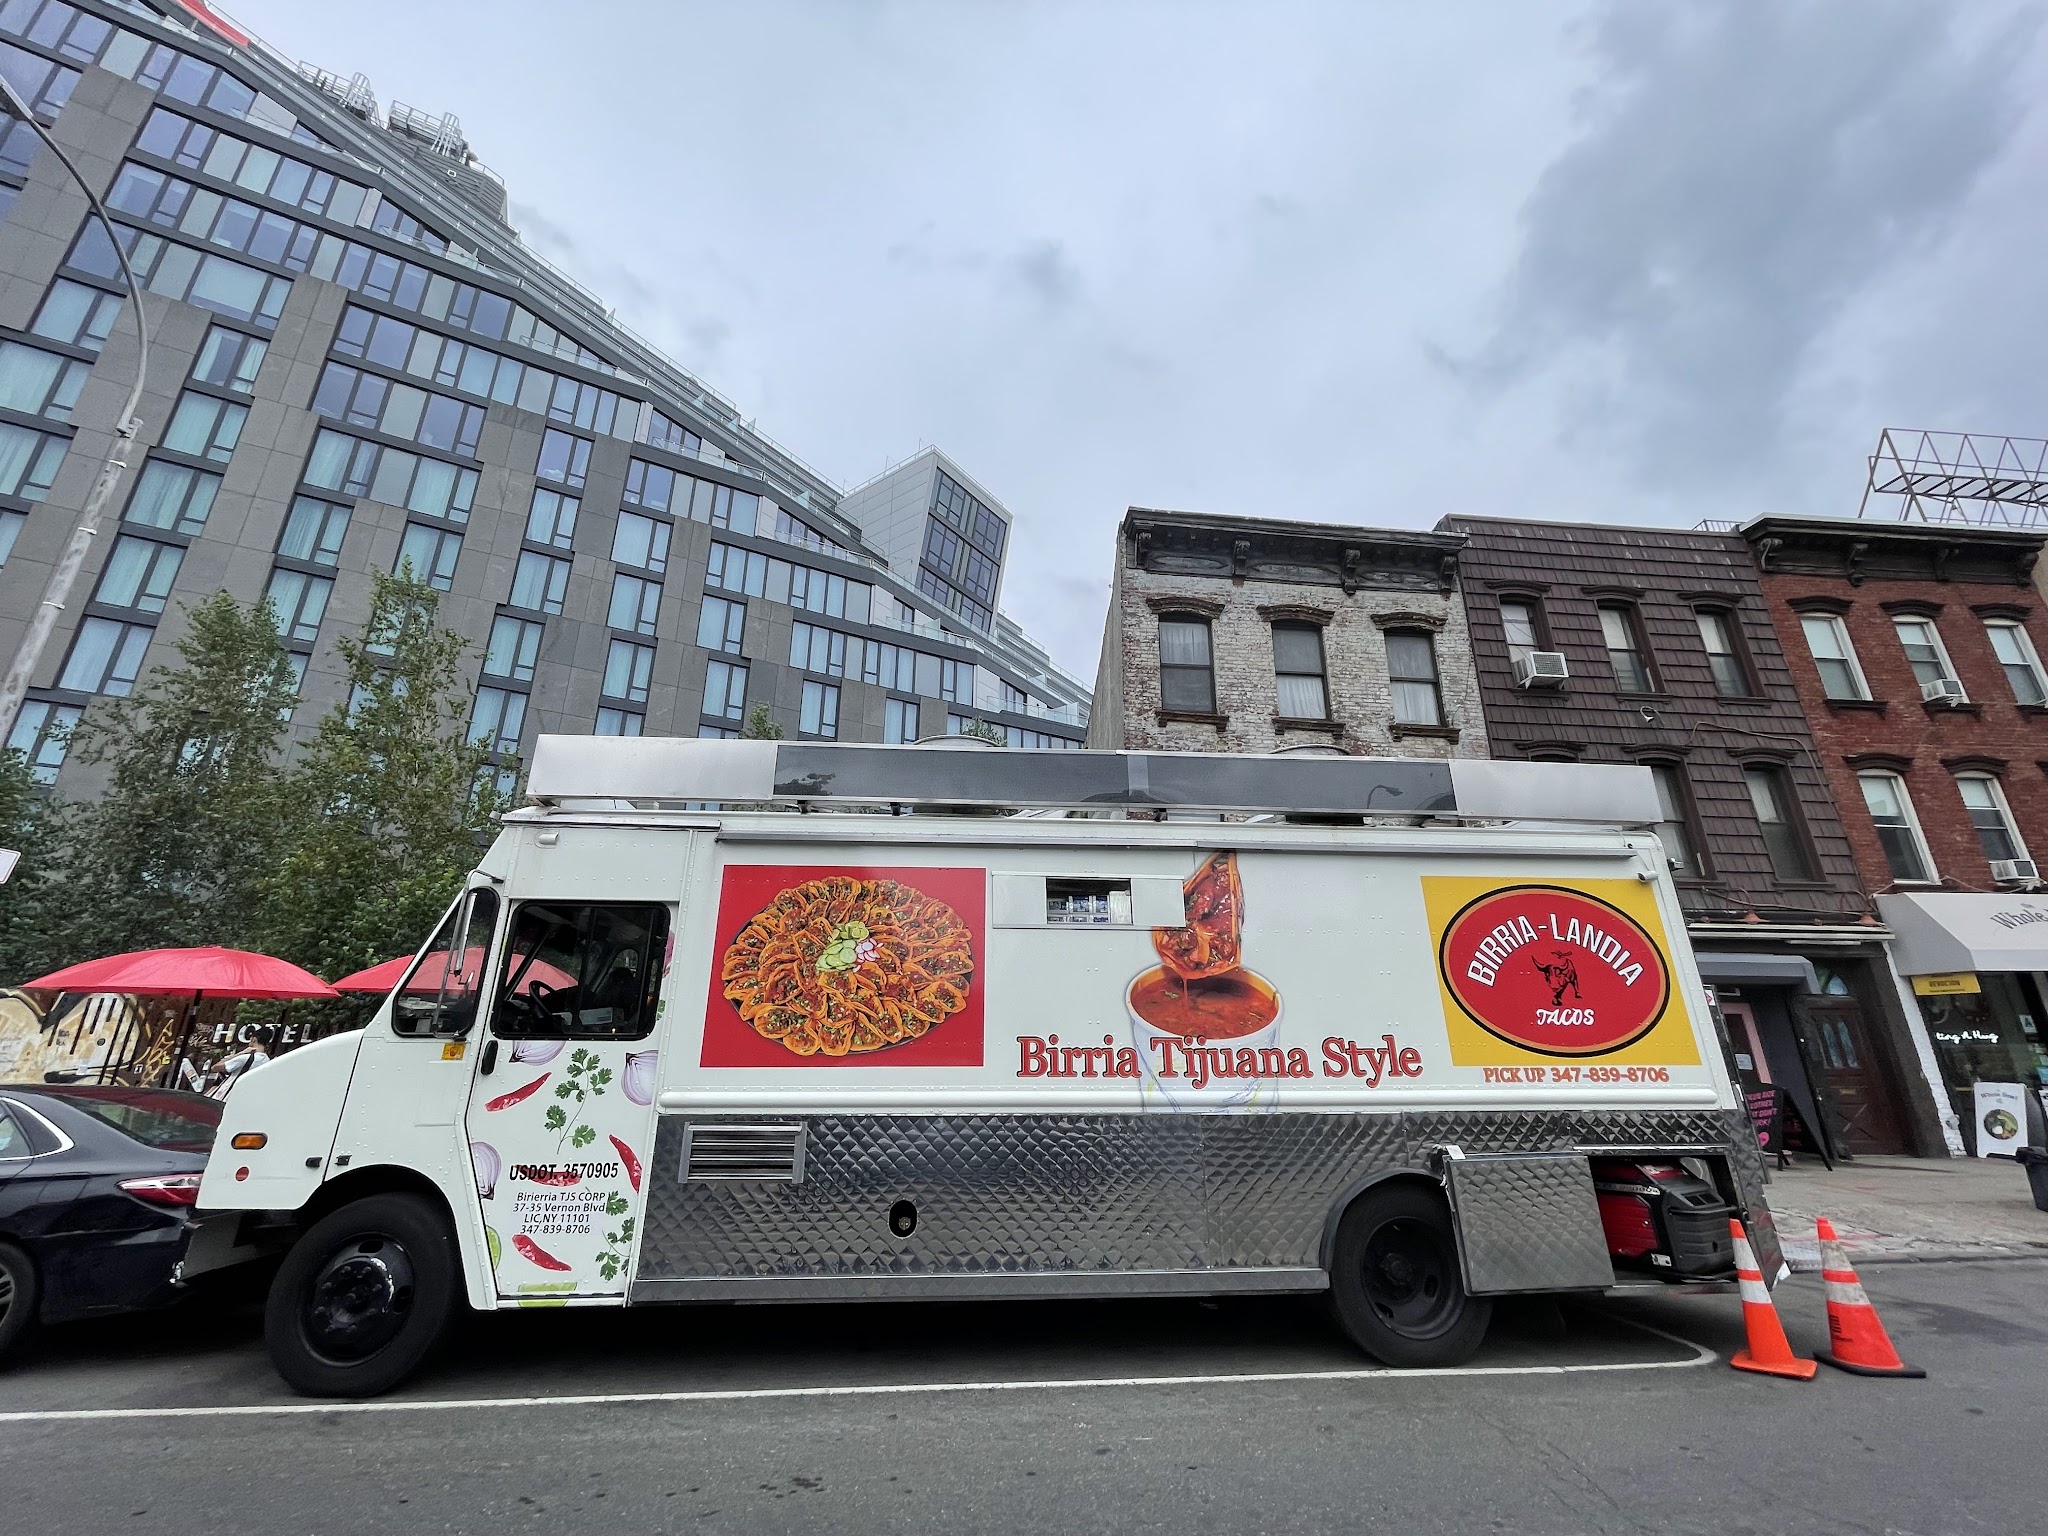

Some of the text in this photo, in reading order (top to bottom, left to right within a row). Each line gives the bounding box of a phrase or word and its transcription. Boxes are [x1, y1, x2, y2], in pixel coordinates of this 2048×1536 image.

[1990, 909, 2048, 929] Whole
[1536, 1008, 1595, 1026] TACOS
[1016, 1034, 1424, 1090] Birria Tijuana Style
[1484, 1067, 1669, 1083] PICK UP 347-839-8706
[563, 1162, 618, 1179] 3570905
[517, 1192, 606, 1202] Birierria TJS CORP
[512, 1202, 606, 1212] 37-35 Vernon Blvd
[524, 1213, 590, 1224] LIC,NY 11101
[520, 1225, 591, 1234] 347-839-8706
